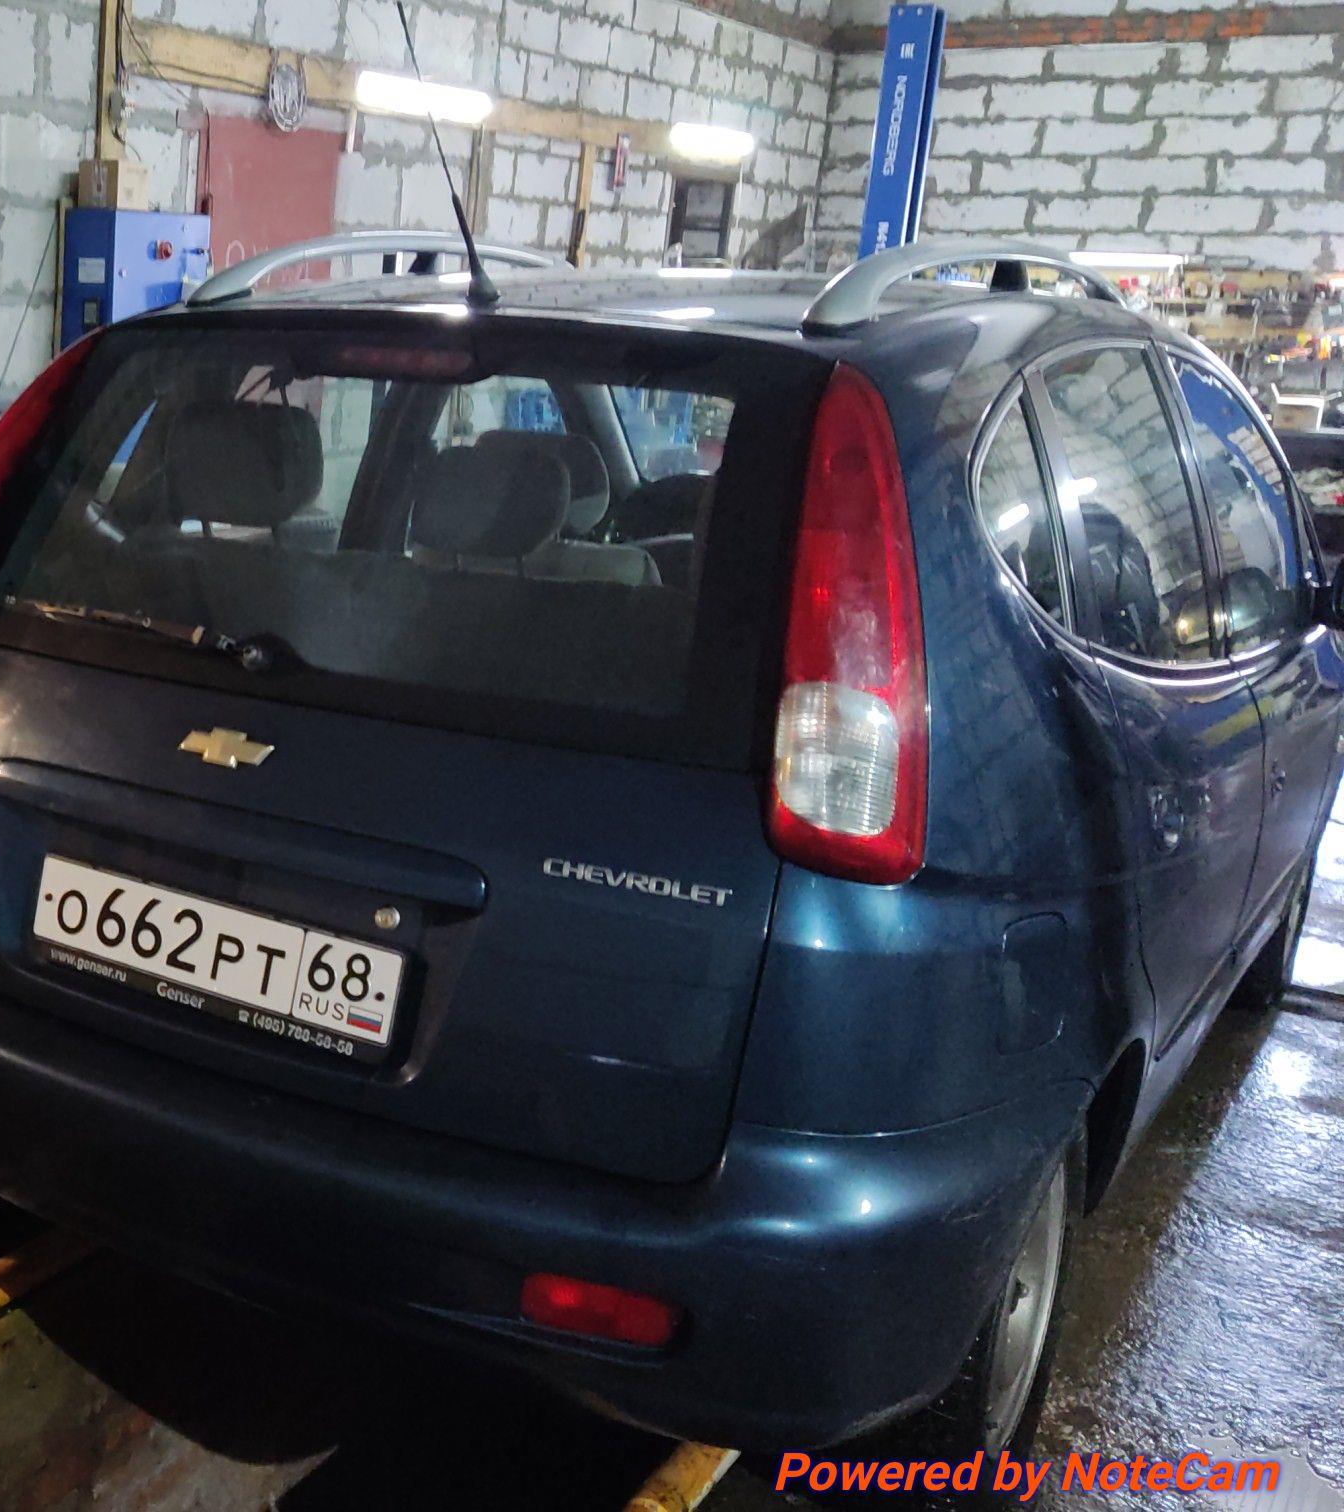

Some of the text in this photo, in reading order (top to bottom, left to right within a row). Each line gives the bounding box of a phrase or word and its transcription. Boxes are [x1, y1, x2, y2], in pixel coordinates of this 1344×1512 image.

[883, 75, 907, 176] NORDBERG
[543, 857, 733, 907] CHEVROLET
[308, 943, 371, 1002] 68
[299, 992, 344, 1020] RUS
